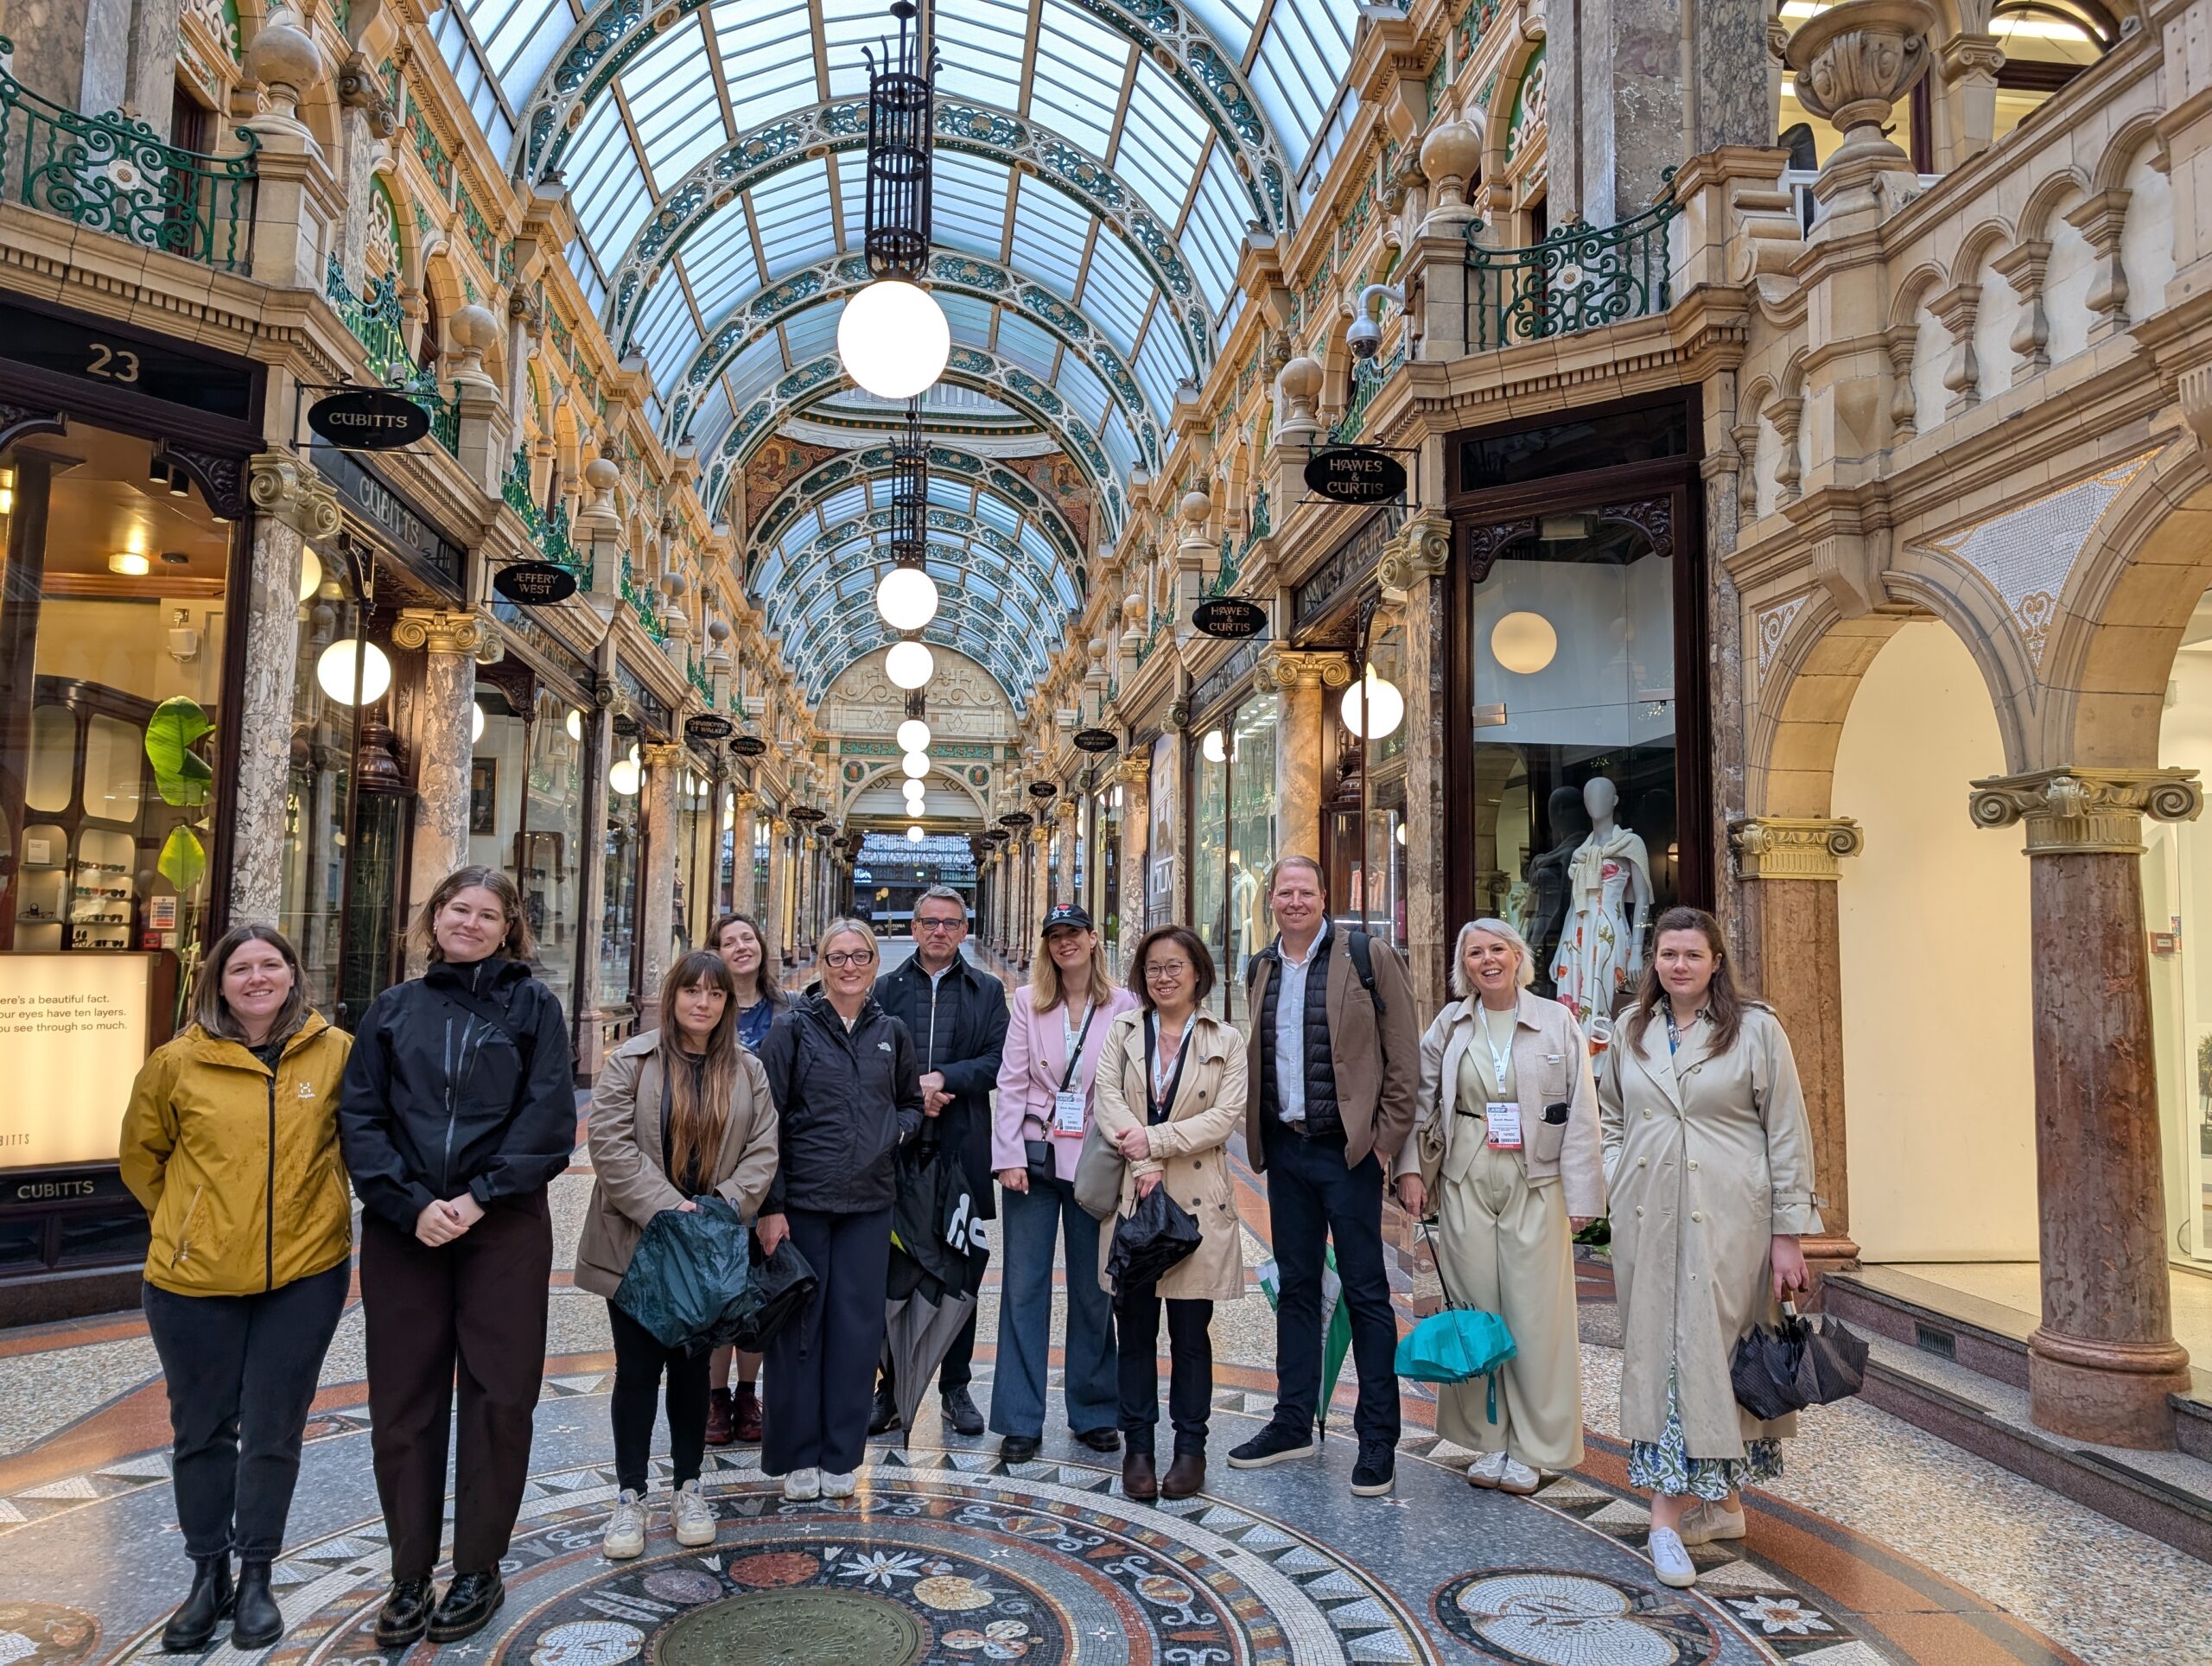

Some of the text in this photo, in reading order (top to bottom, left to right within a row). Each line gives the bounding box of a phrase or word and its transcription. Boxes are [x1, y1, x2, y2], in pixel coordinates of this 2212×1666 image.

[87, 343, 139, 382] 23
[328, 412, 408, 429] CUBITTS
[1330, 459, 1382, 473] HAWES
[1351, 472, 1360, 481] &
[1326, 481, 1383, 495] CURTIS
[359, 476, 420, 549] CUBITTS
[513, 572, 559, 584] JEFFERY
[518, 583, 552, 595] WEST
[1211, 607, 1249, 616] HAWES
[1209, 622, 1250, 632] CURTIS
[0, 995, 25, 1005] ere's
[38, 995, 84, 1004] beautiful
[87, 994, 110, 1003] fact.
[18, 1011, 43, 1020] eyes
[47, 1008, 72, 1018] have
[74, 1009, 91, 1018] ten
[94, 1008, 126, 1018] layers.
[36, 1022, 78, 1033] through
[96, 1021, 127, 1030] much.
[0, 1133, 29, 1147] BITTS
[17, 1180, 94, 1199] CUBITTS
